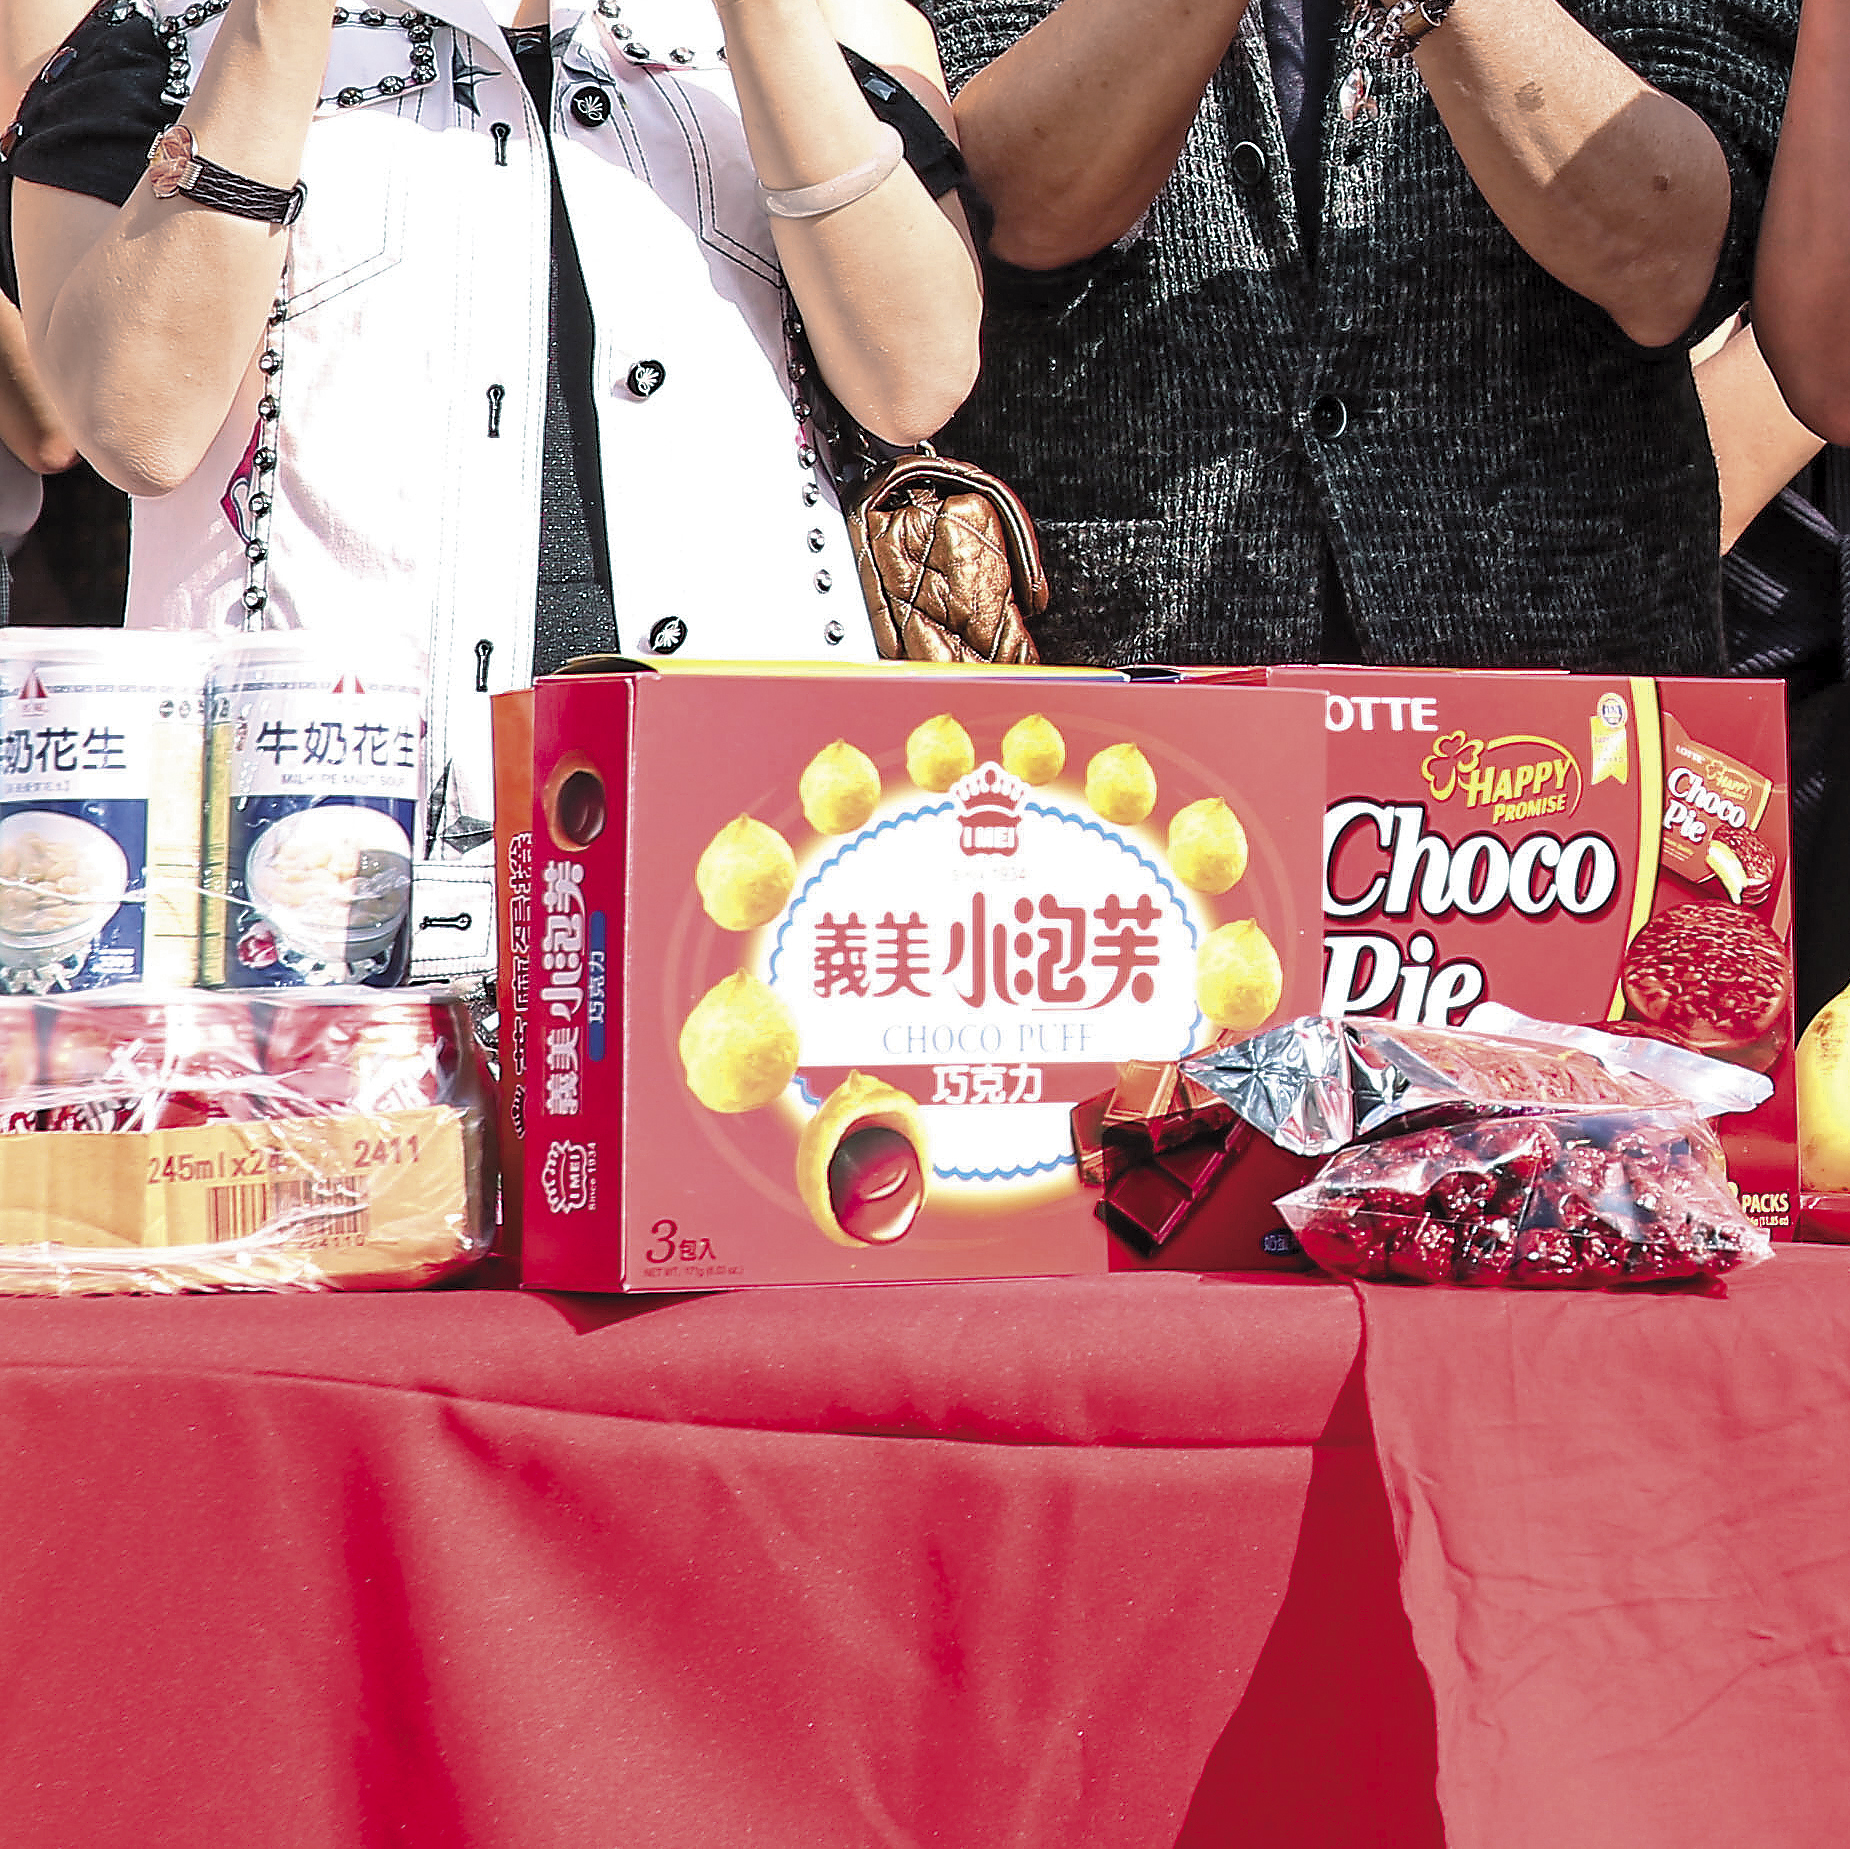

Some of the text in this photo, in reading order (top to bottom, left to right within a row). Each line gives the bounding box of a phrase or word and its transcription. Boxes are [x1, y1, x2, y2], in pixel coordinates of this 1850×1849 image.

[256, 720, 416, 768] 牛奶花生
[1466, 750, 1573, 809] HAPPY
[1667, 767, 1747, 829] Choco
[1492, 793, 1567, 825] PROMISE
[1662, 800, 1707, 843] Pie
[1324, 800, 1618, 917] Choco
[813, 891, 1163, 1011] 義美小泡芙
[540, 861, 588, 1116] 義美小泡芙
[588, 950, 605, 1025] 巧克力
[1324, 932, 1486, 1027] Pie
[882, 1023, 1093, 1054] CHOCO PUFF
[931, 1062, 1044, 1104] 巧克力
[355, 1135, 420, 1169] 2411
[587, 1141, 598, 1174] 1934
[1742, 1192, 1790, 1213] PACKS
[646, 1219, 717, 1264] 3包入
